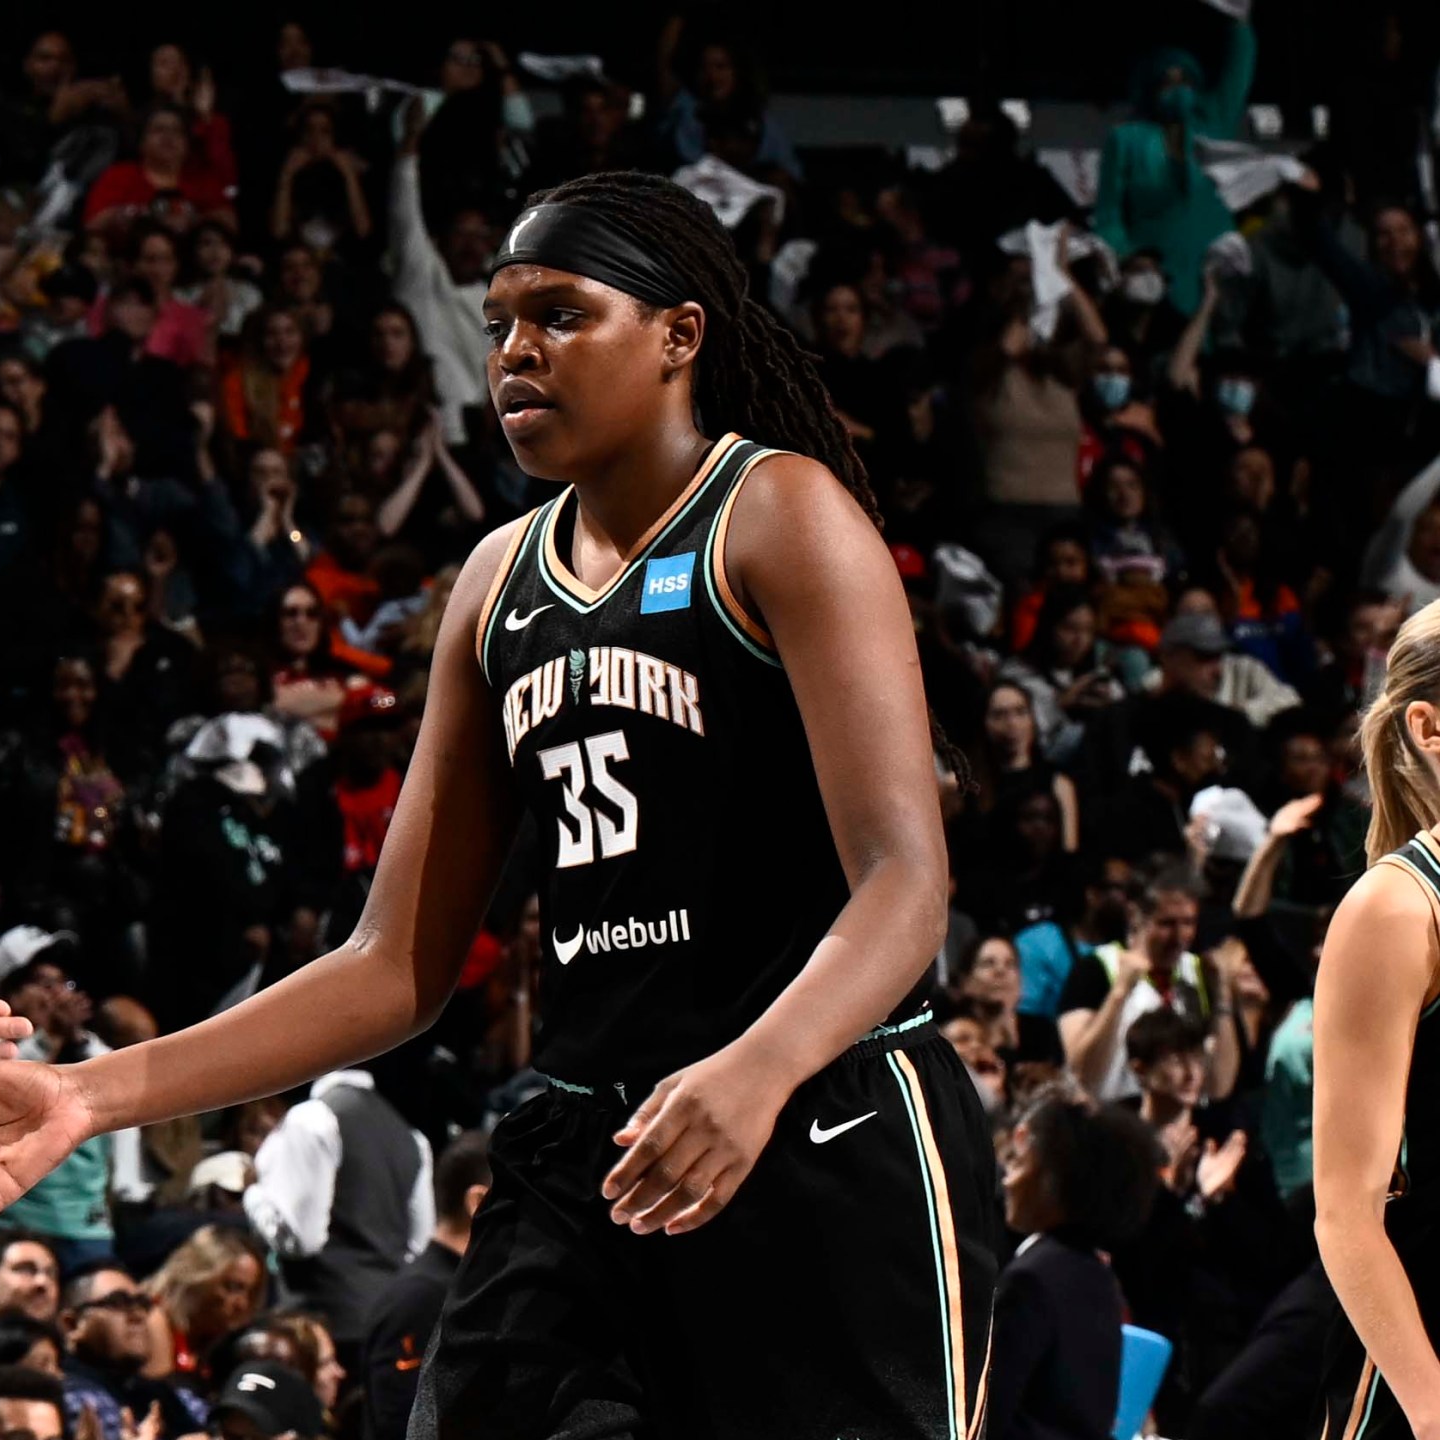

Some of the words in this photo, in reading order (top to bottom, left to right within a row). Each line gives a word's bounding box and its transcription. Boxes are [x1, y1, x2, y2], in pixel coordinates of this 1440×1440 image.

[648, 571, 689, 596] HSS
[502, 658, 567, 769] NEW
[588, 645, 706, 738] YORK
[536, 729, 639, 869] 35
[585, 908, 691, 955] Webull
